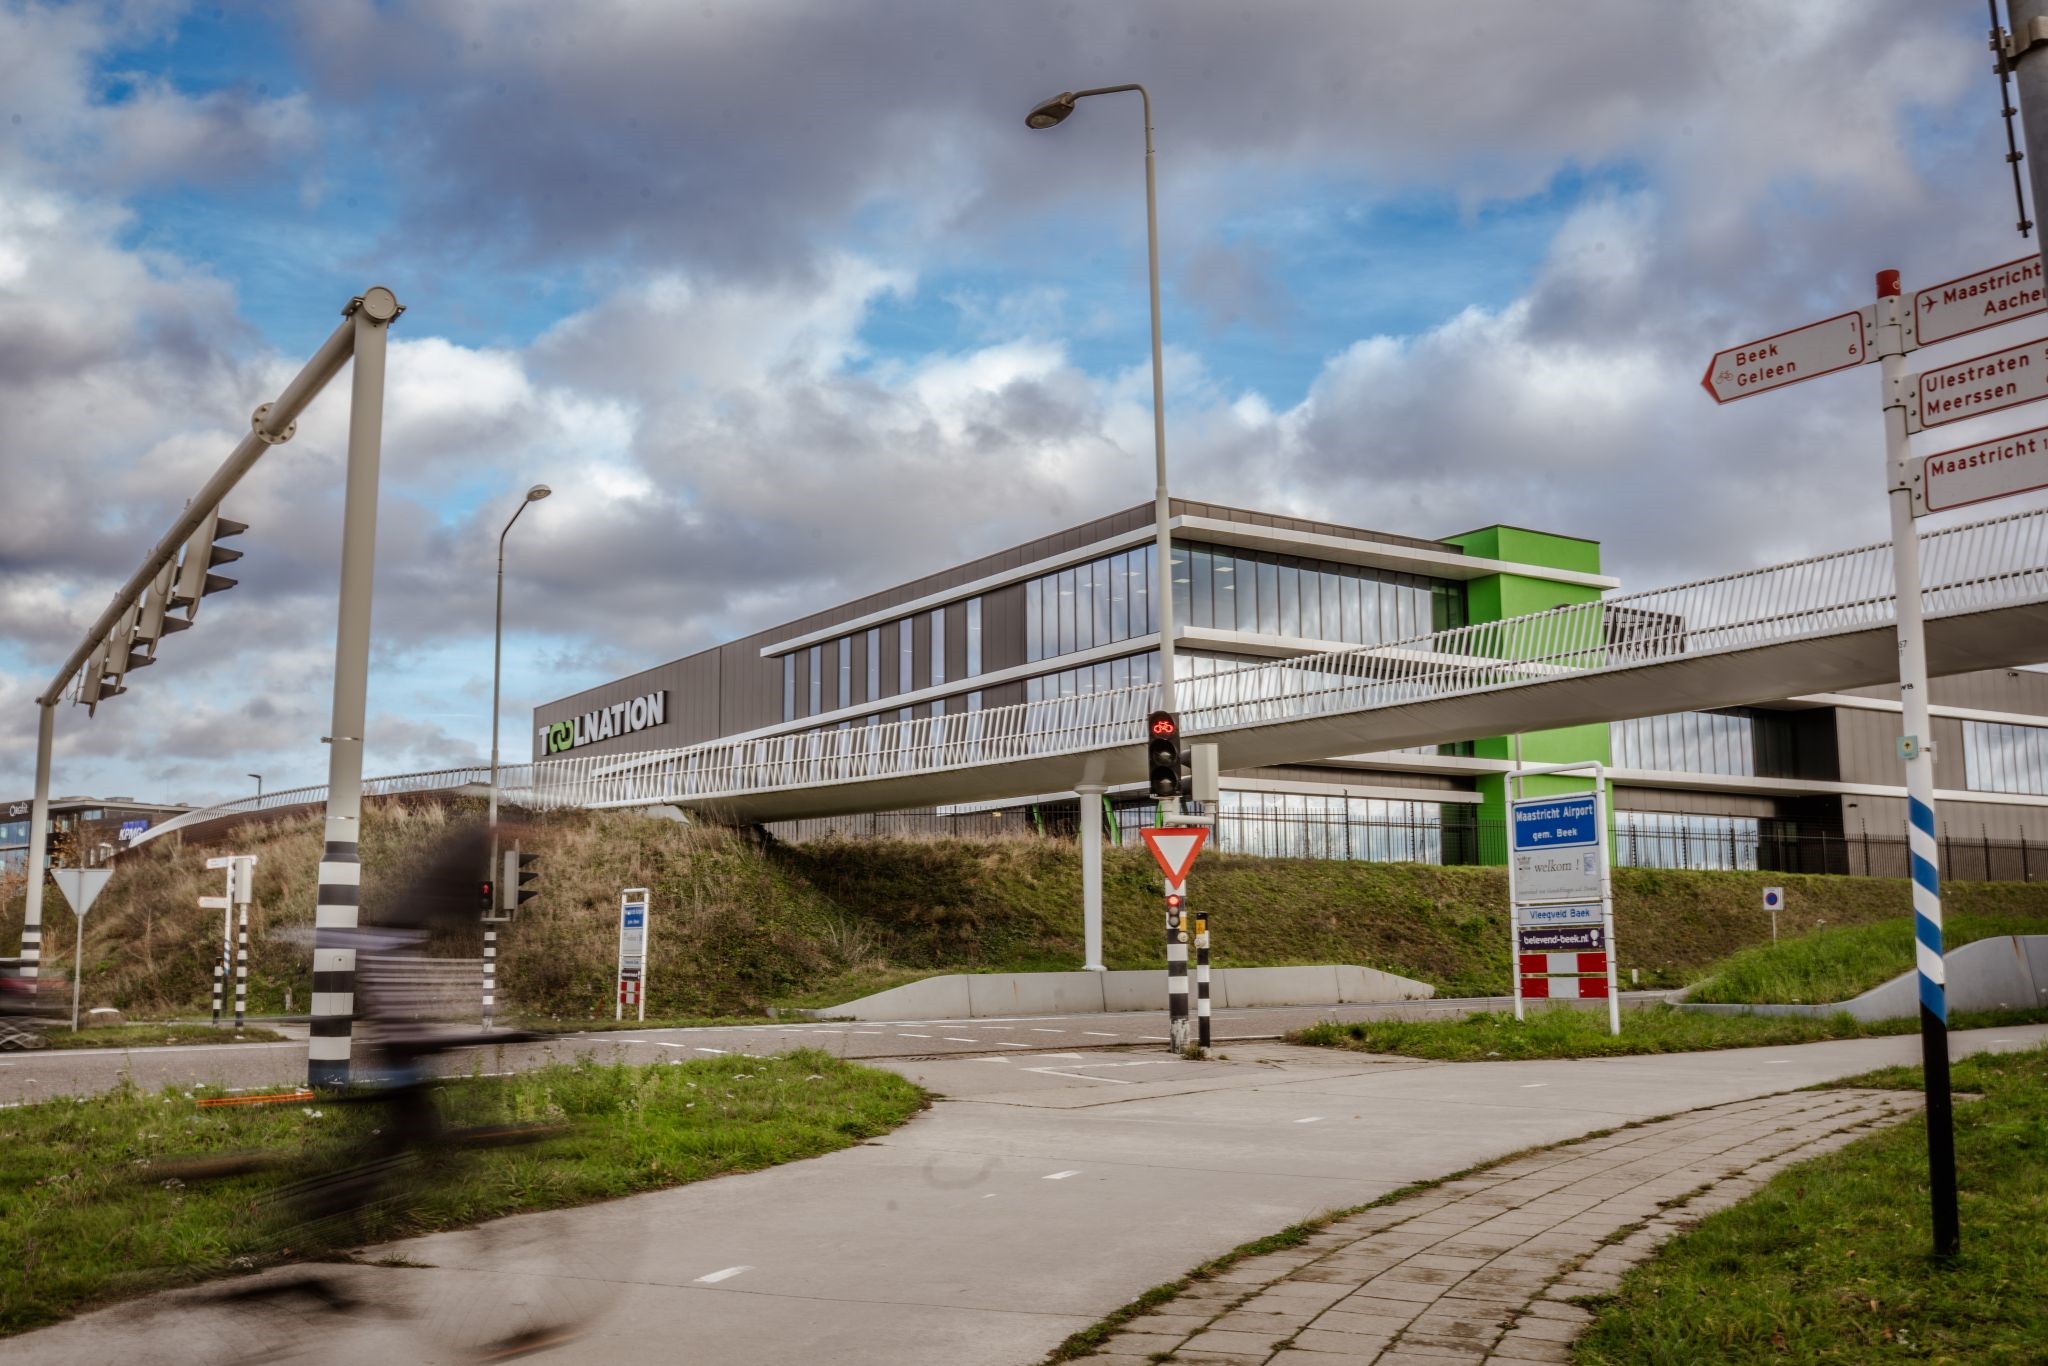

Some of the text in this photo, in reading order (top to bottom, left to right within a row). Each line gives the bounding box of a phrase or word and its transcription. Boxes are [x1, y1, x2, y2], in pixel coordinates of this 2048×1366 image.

[1943, 262, 2041, 305] Maastricht
[1736, 322, 1856, 366] Beek 1
[1737, 344, 1857, 386] Geleen 6
[1926, 355, 2029, 392] Ulestraten
[1927, 382, 2016, 416] Meerssen
[1931, 439, 2036, 477] Maastricht
[538, 690, 665, 756] TOOLNATION
[1516, 804, 1593, 823] Maastricht Airport
[1532, 828, 1578, 842] gem. Beek
[1534, 859, 1573, 872] welkom
